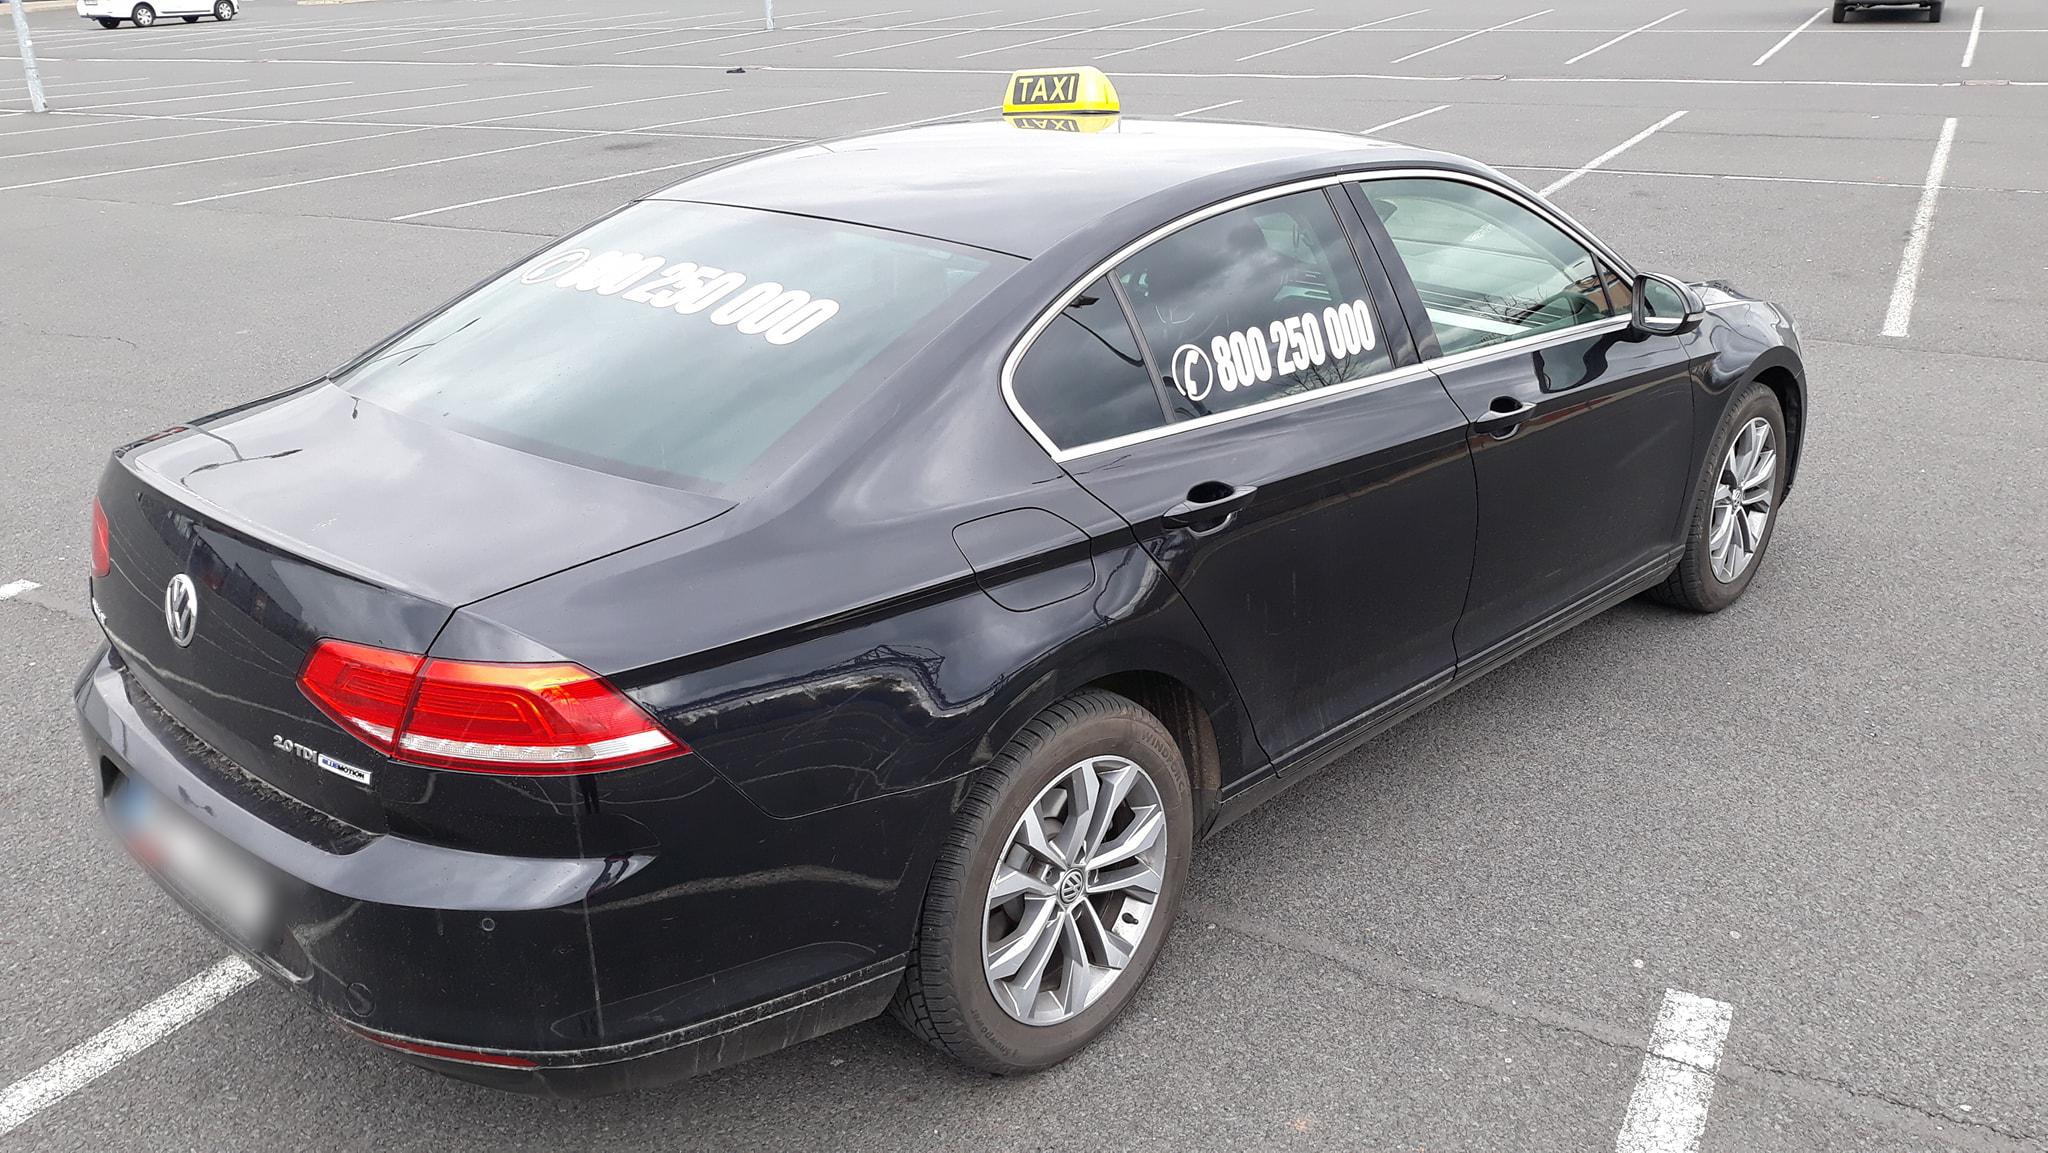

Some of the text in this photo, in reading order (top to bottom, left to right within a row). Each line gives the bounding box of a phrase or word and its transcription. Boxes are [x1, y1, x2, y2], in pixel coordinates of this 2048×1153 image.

[1019, 75, 1075, 102] TAXI
[622, 262, 747, 314] 250
[710, 282, 840, 345] 000
[1211, 299, 1376, 392] 800 250 000
